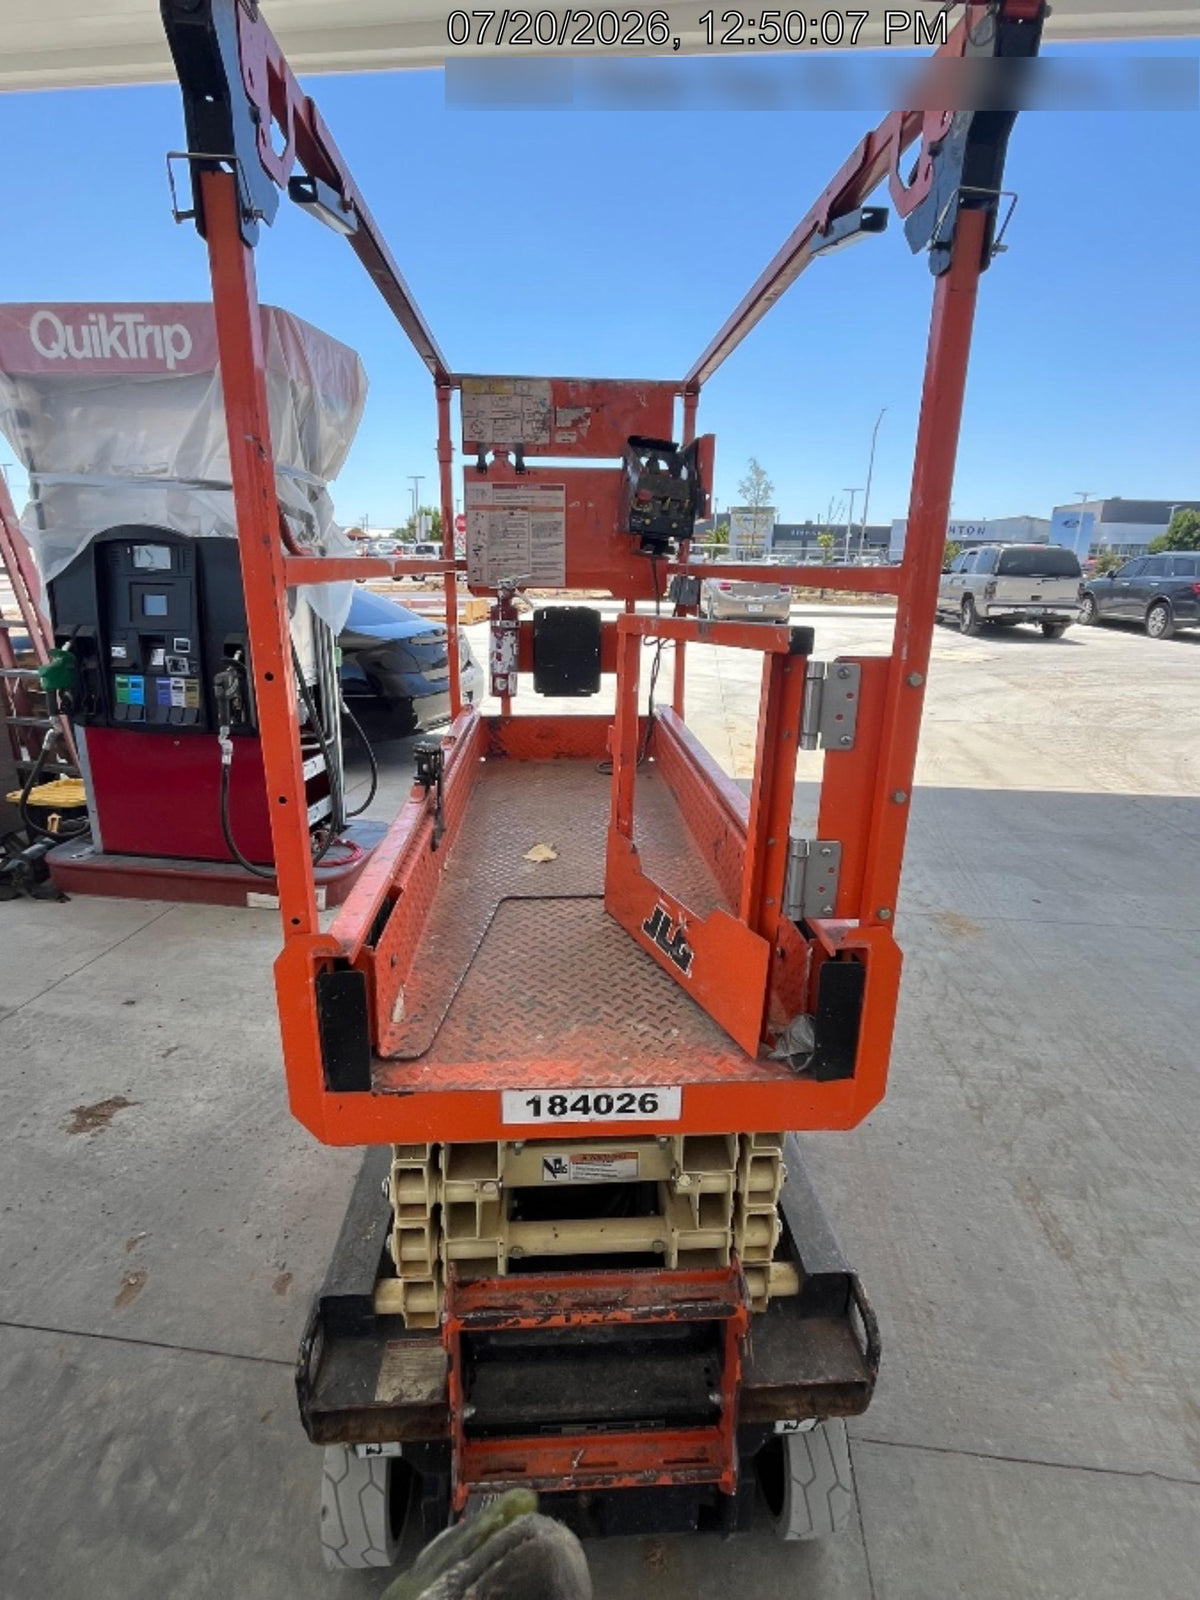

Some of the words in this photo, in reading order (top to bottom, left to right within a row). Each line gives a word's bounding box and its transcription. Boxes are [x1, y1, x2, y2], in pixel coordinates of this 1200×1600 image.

[29, 310, 193, 370] QuikTrip
[642, 903, 695, 976] JLG
[525, 1093, 659, 1117] 184026
